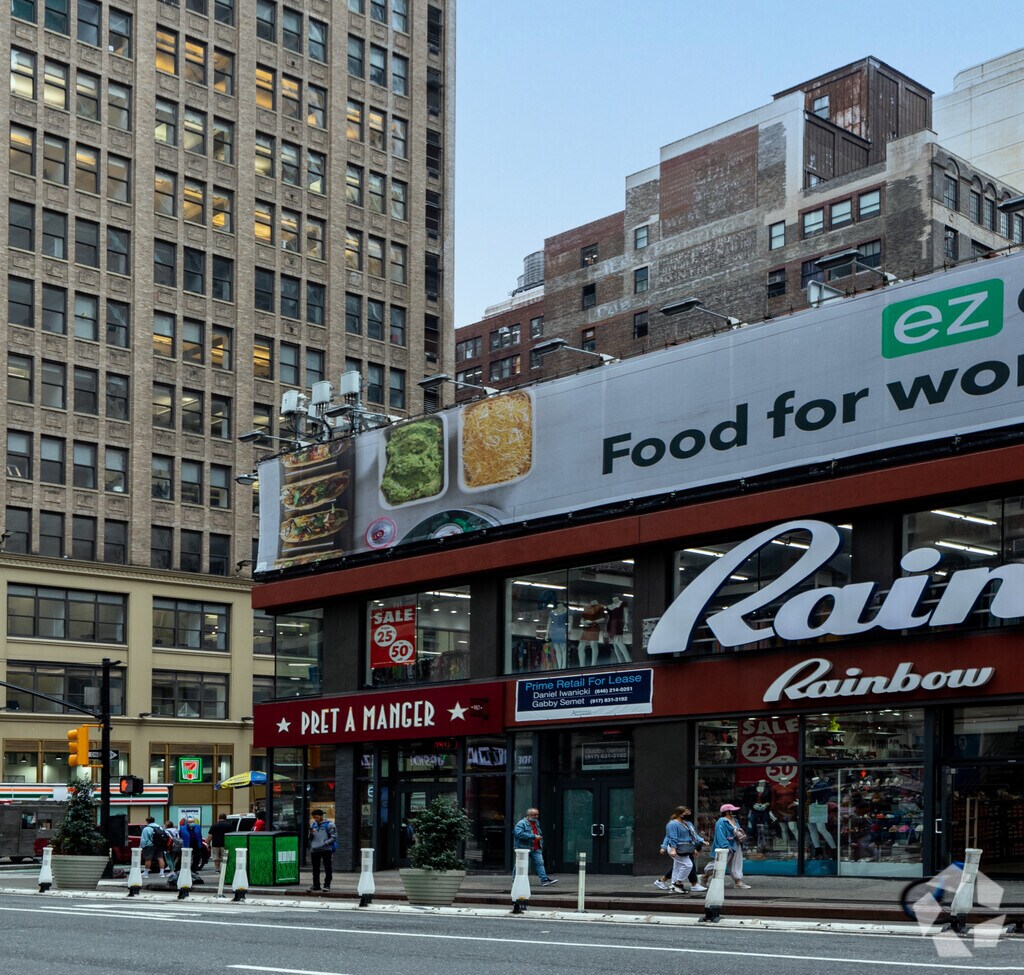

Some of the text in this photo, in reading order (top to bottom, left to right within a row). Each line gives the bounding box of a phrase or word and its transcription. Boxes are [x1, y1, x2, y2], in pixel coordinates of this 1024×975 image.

[893, 290, 990, 345] ez
[602, 402, 749, 476] Food
[766, 387, 870, 439] for
[373, 608, 413, 624] SALE
[525, 674, 642, 691] Prime Retail For Lease
[763, 657, 996, 703] Rainbow
[533, 691, 558, 699] Daniel
[559, 688, 591, 697] Iwanicki
[532, 700, 558, 708] Gabby
[301, 699, 435, 735] PRET A MANGER
[742, 717, 799, 735] SALE
